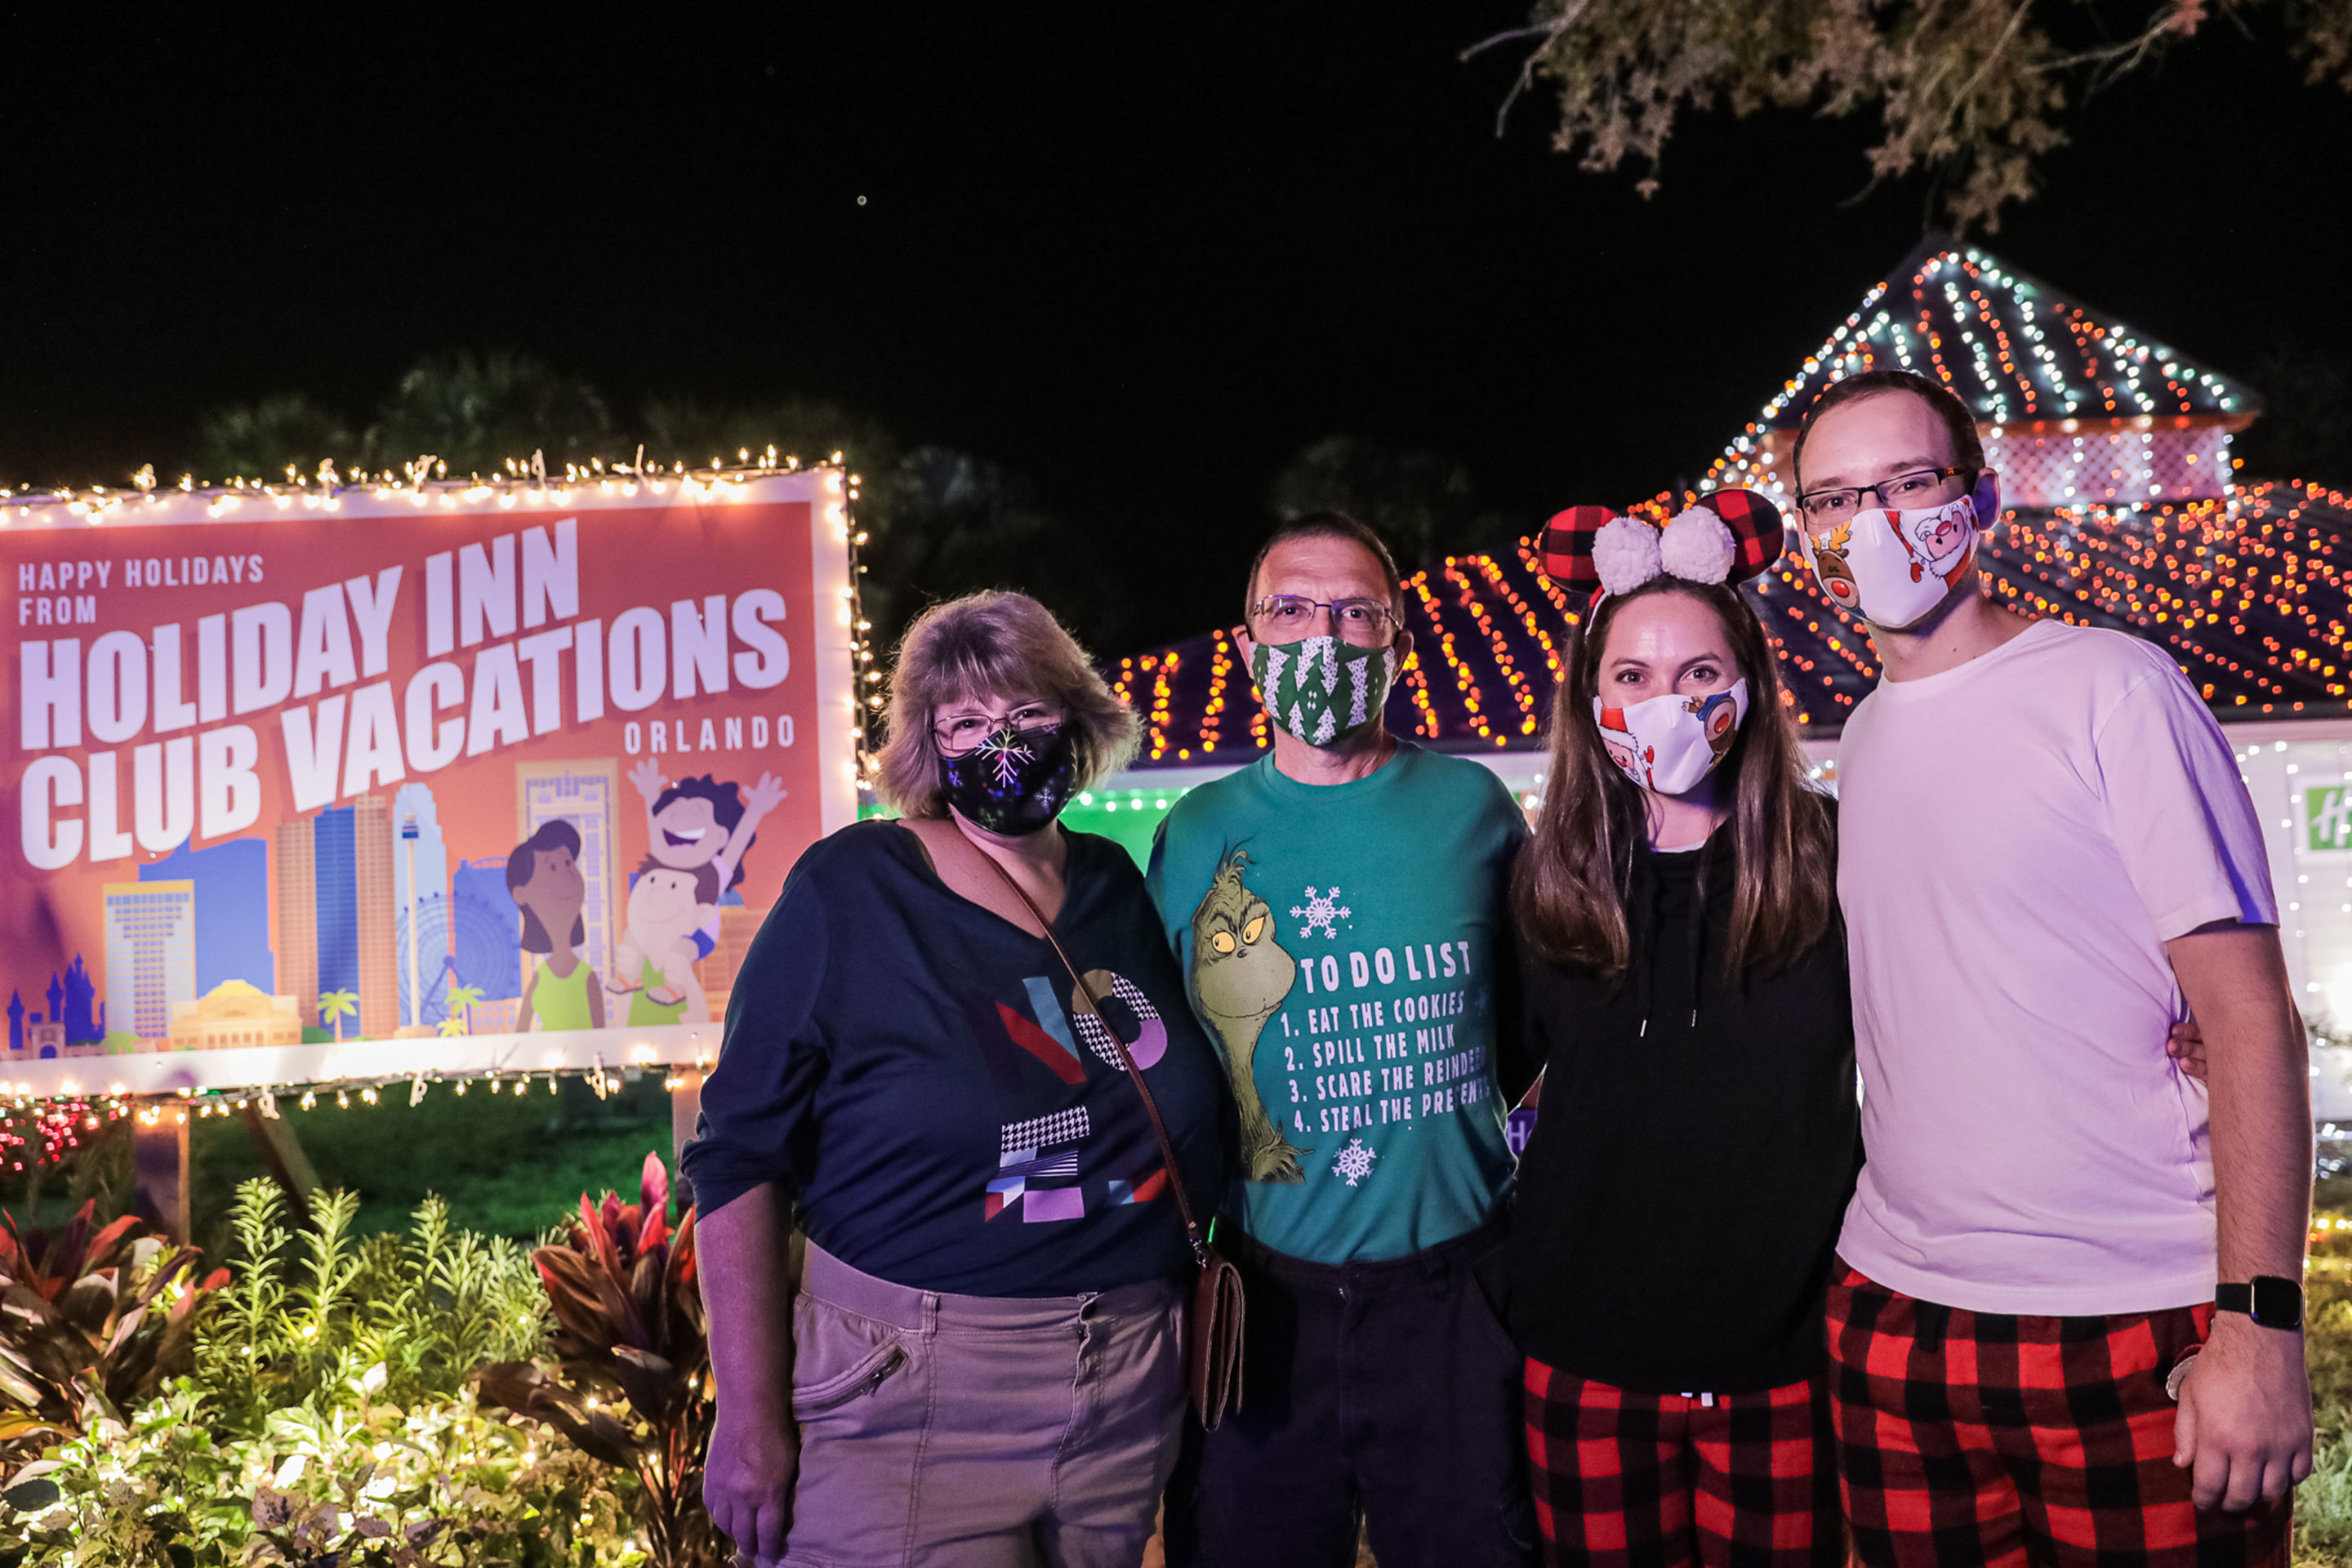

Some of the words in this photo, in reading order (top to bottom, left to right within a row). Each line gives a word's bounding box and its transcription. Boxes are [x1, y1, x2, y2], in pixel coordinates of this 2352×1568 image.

[19, 559, 112, 591] HAPPY
[125, 555, 264, 587] HOLIDAYS
[19, 595, 96, 626] FROM
[20, 564, 403, 751] HOLIDAY
[425, 517, 580, 658] INN
[20, 724, 261, 871] CLUB
[281, 588, 791, 813] VACATIONS
[624, 715, 795, 756] ORLANDO
[1300, 955, 1339, 994] TO
[1349, 947, 1396, 988] DO
[1405, 941, 1470, 981] LIST
[1281, 1013, 1299, 1037] 1.
[1308, 1007, 1339, 1034] EAT
[1350, 1001, 1383, 1029] THE
[1393, 991, 1463, 1023] COOKIES
[1284, 1046, 1303, 1071] 2.
[1312, 1037, 1365, 1068] SPILL
[1374, 1032, 1407, 1060] THE
[1416, 1024, 1454, 1054] MILK
[1289, 1079, 1307, 1102] 3.
[1316, 1070, 1372, 1100] SCARE
[1381, 1065, 1414, 1092] THE
[1294, 1109, 1311, 1132] 4.
[1321, 1103, 1372, 1132] STEAL
[1380, 1097, 1412, 1124] THE
